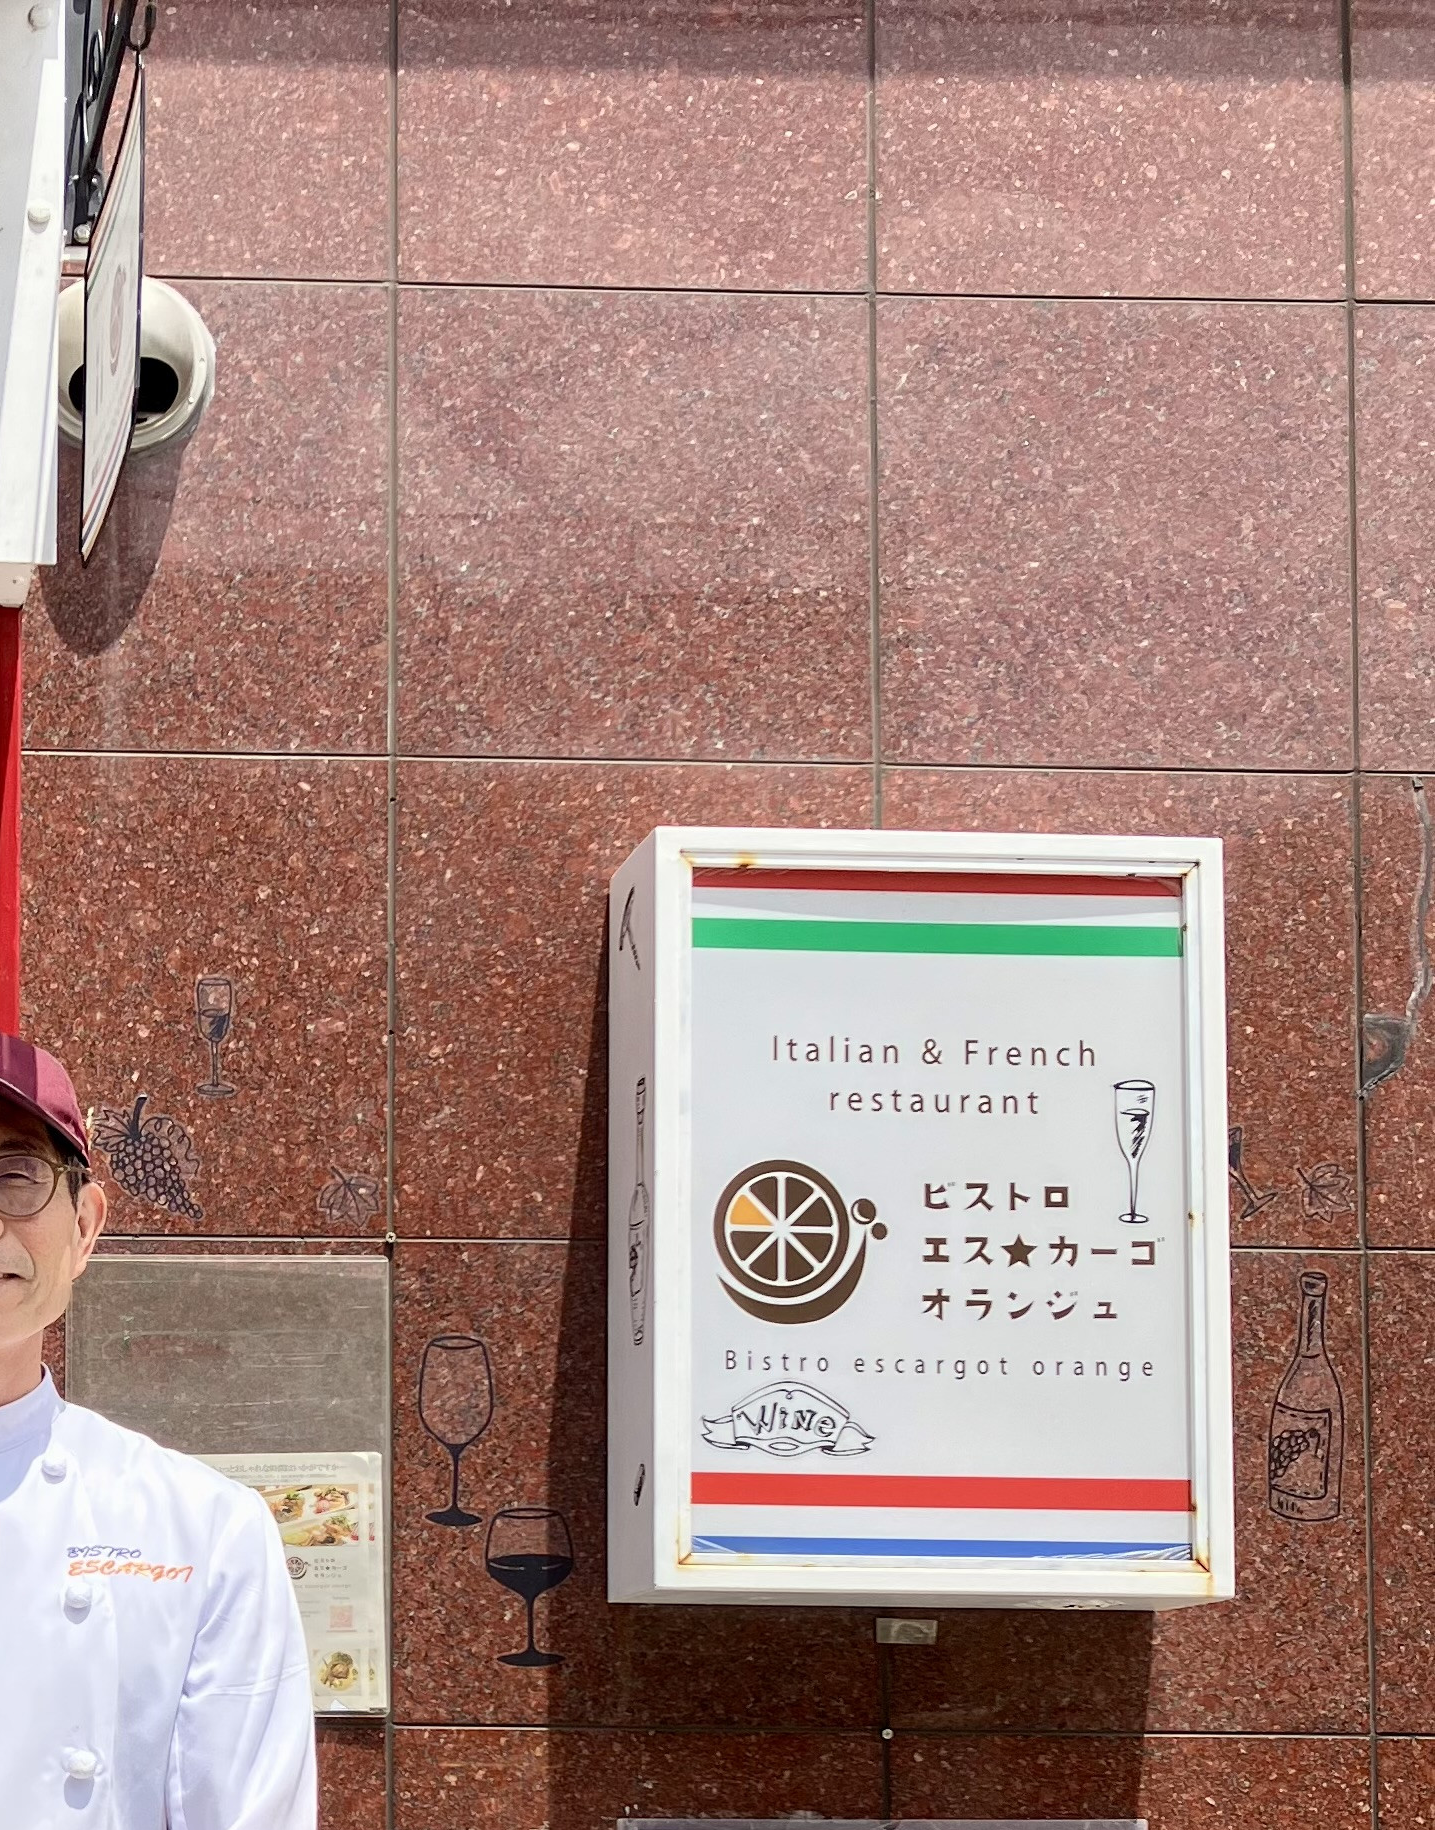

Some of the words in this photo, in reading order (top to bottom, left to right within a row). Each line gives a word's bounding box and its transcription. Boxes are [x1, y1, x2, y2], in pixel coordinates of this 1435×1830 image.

[772, 1035, 900, 1064] Italian
[921, 1038, 943, 1065] &
[964, 1039, 1096, 1067] French
[829, 1088, 1040, 1115] restaurant
[922, 1181, 1070, 1211] ビストロ
[922, 1288, 1118, 1321] オランジュ
[724, 1349, 830, 1373] Bistro
[853, 1354, 1009, 1381] escargot
[1031, 1358, 1155, 1382] orange
